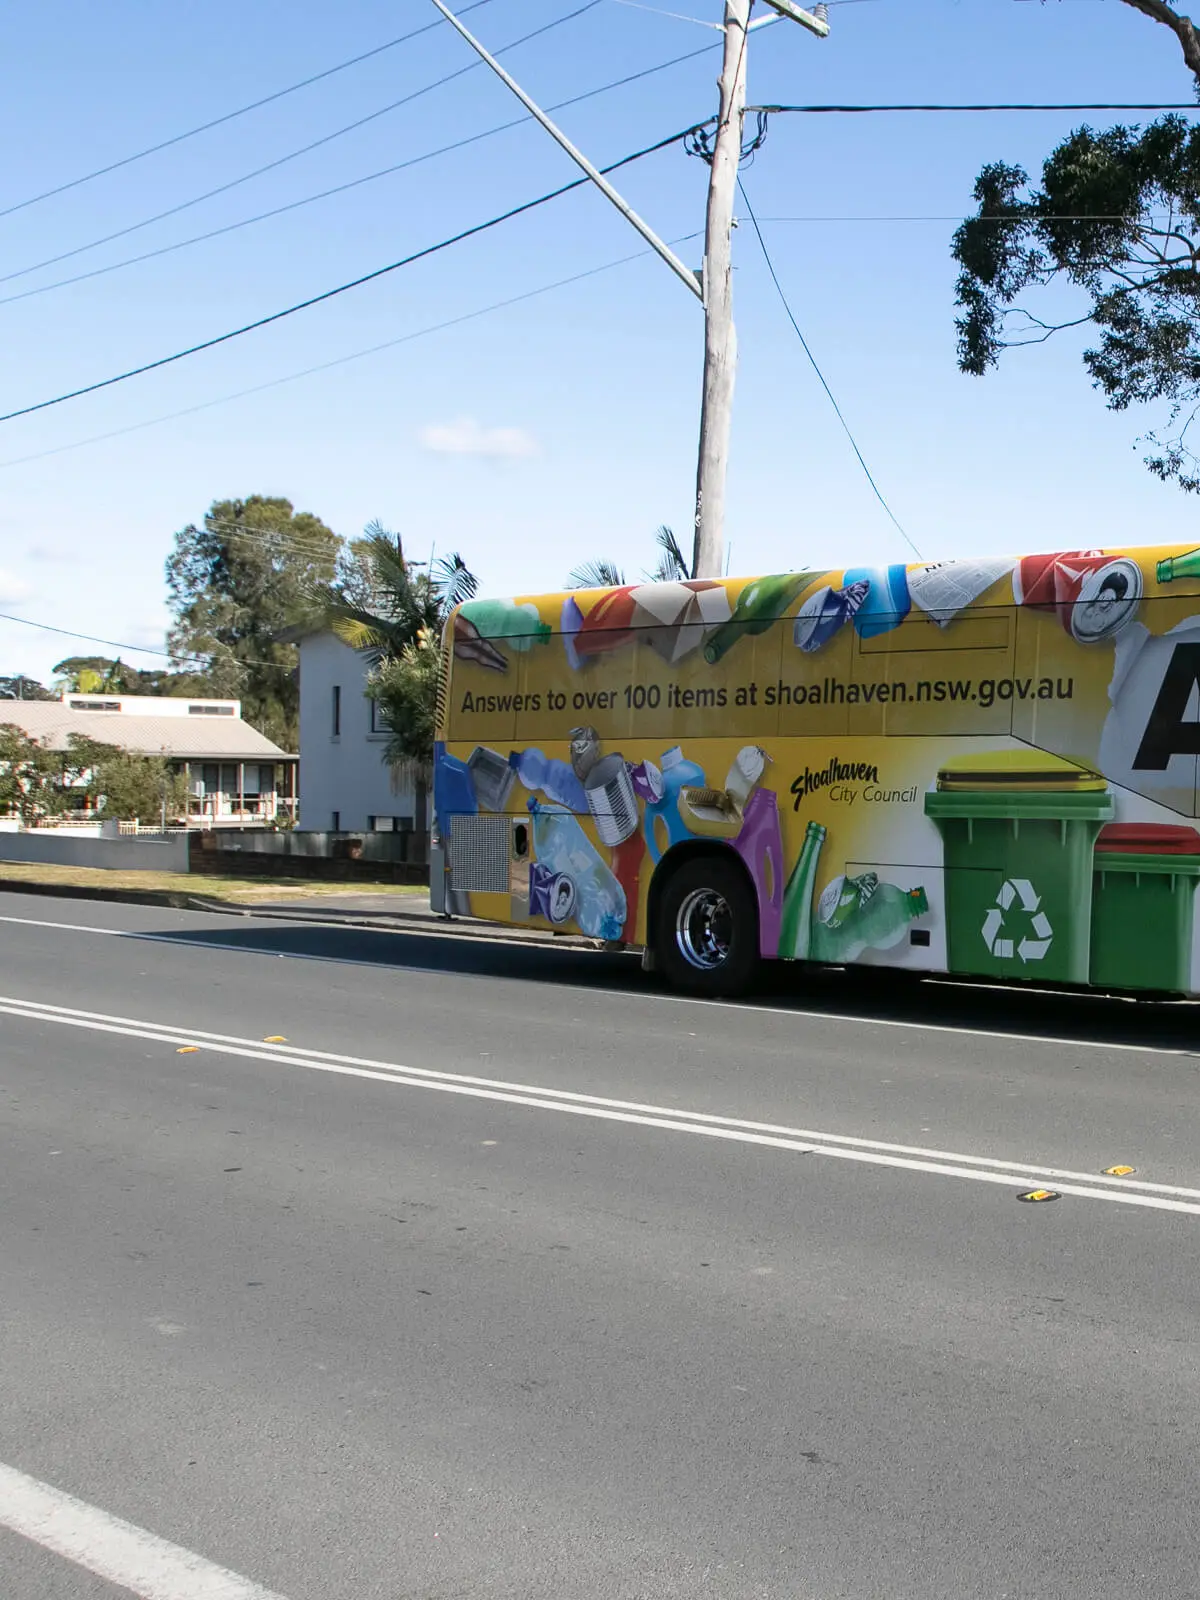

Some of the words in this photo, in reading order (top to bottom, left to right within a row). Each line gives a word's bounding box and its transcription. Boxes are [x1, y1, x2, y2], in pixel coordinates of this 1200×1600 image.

[461, 690, 542, 713] Answers
[546, 689, 567, 711] to
[571, 690, 619, 711] over
[623, 684, 662, 709] 100
[667, 683, 728, 708] items
[734, 682, 758, 706] at
[764, 677, 1075, 707] shoalhaven.nsw.gov.au
[790, 757, 880, 813] Shoalhaven
[828, 785, 858, 806] City
[862, 785, 918, 803] Council
